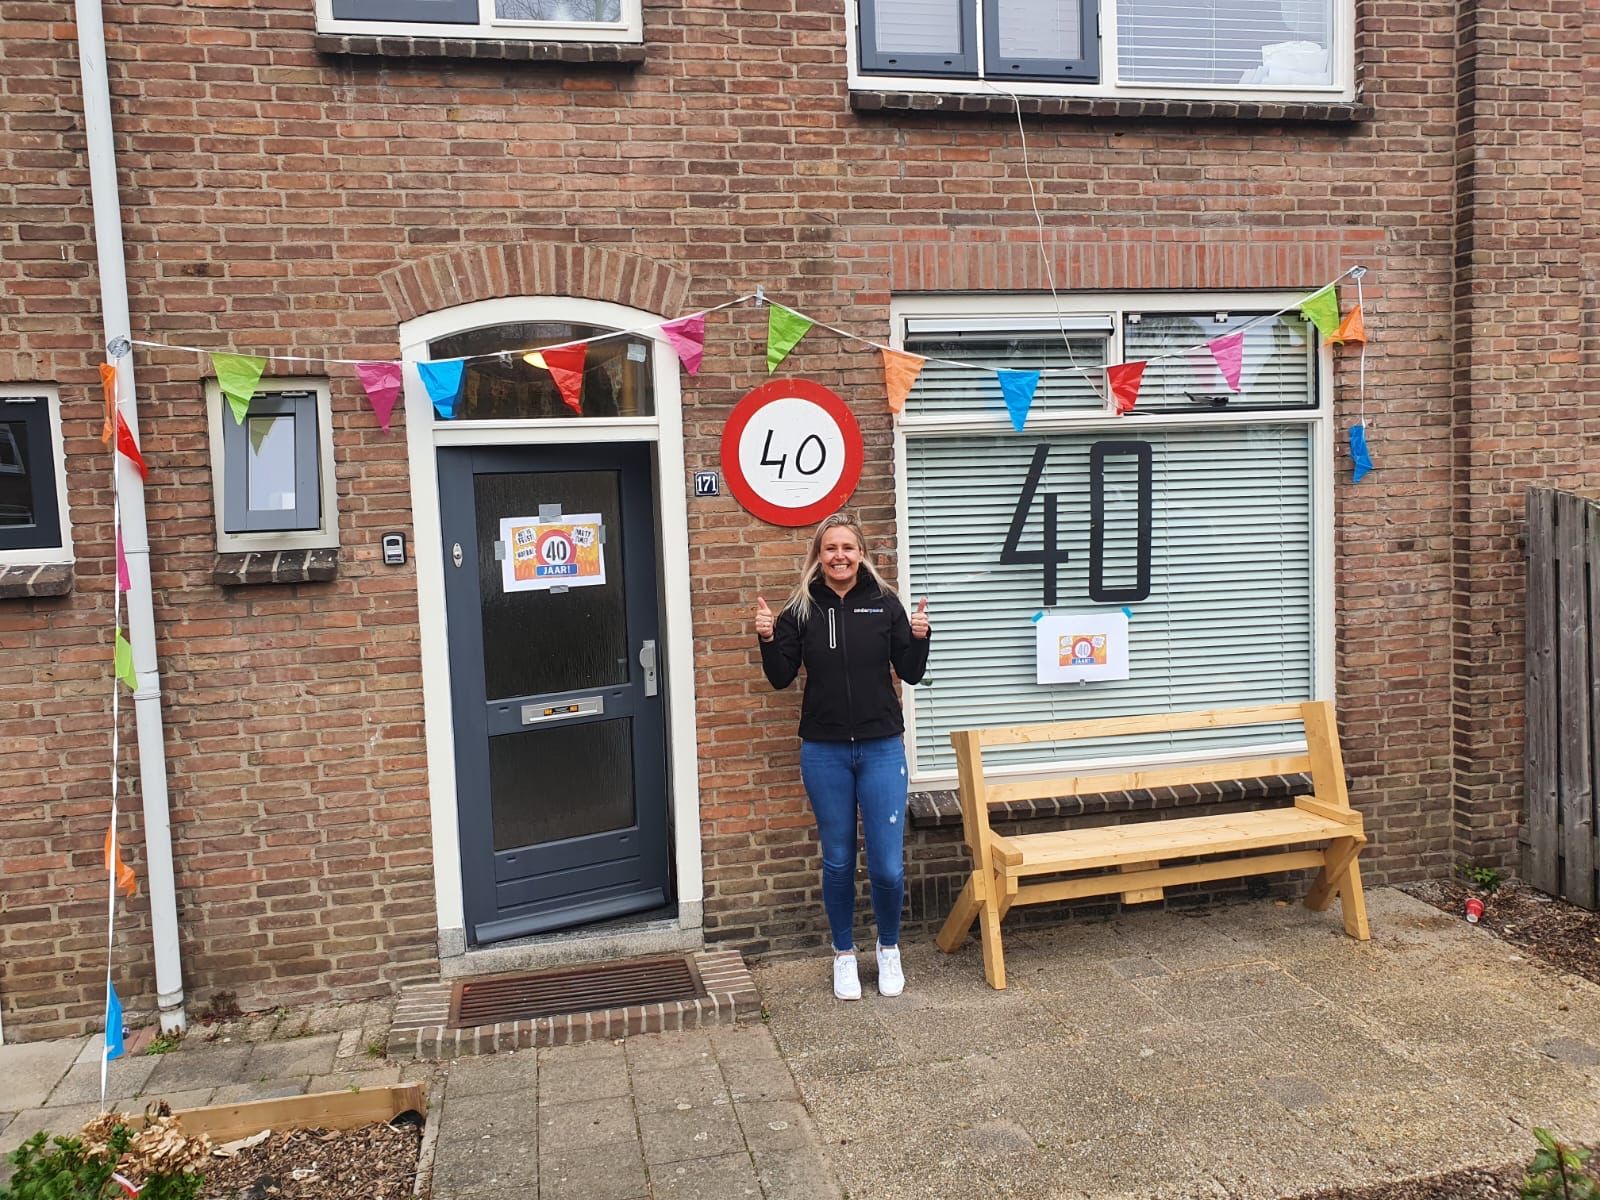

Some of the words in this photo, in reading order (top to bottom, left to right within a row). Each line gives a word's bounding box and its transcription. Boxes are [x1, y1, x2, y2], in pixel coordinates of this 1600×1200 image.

[760, 429, 827, 479] 40
[697, 475, 717, 492] 171
[1000, 440, 1152, 606] 40
[546, 540, 567, 561] 40
[543, 565, 571, 575] JAAR!
[1078, 644, 1089, 656] 40
